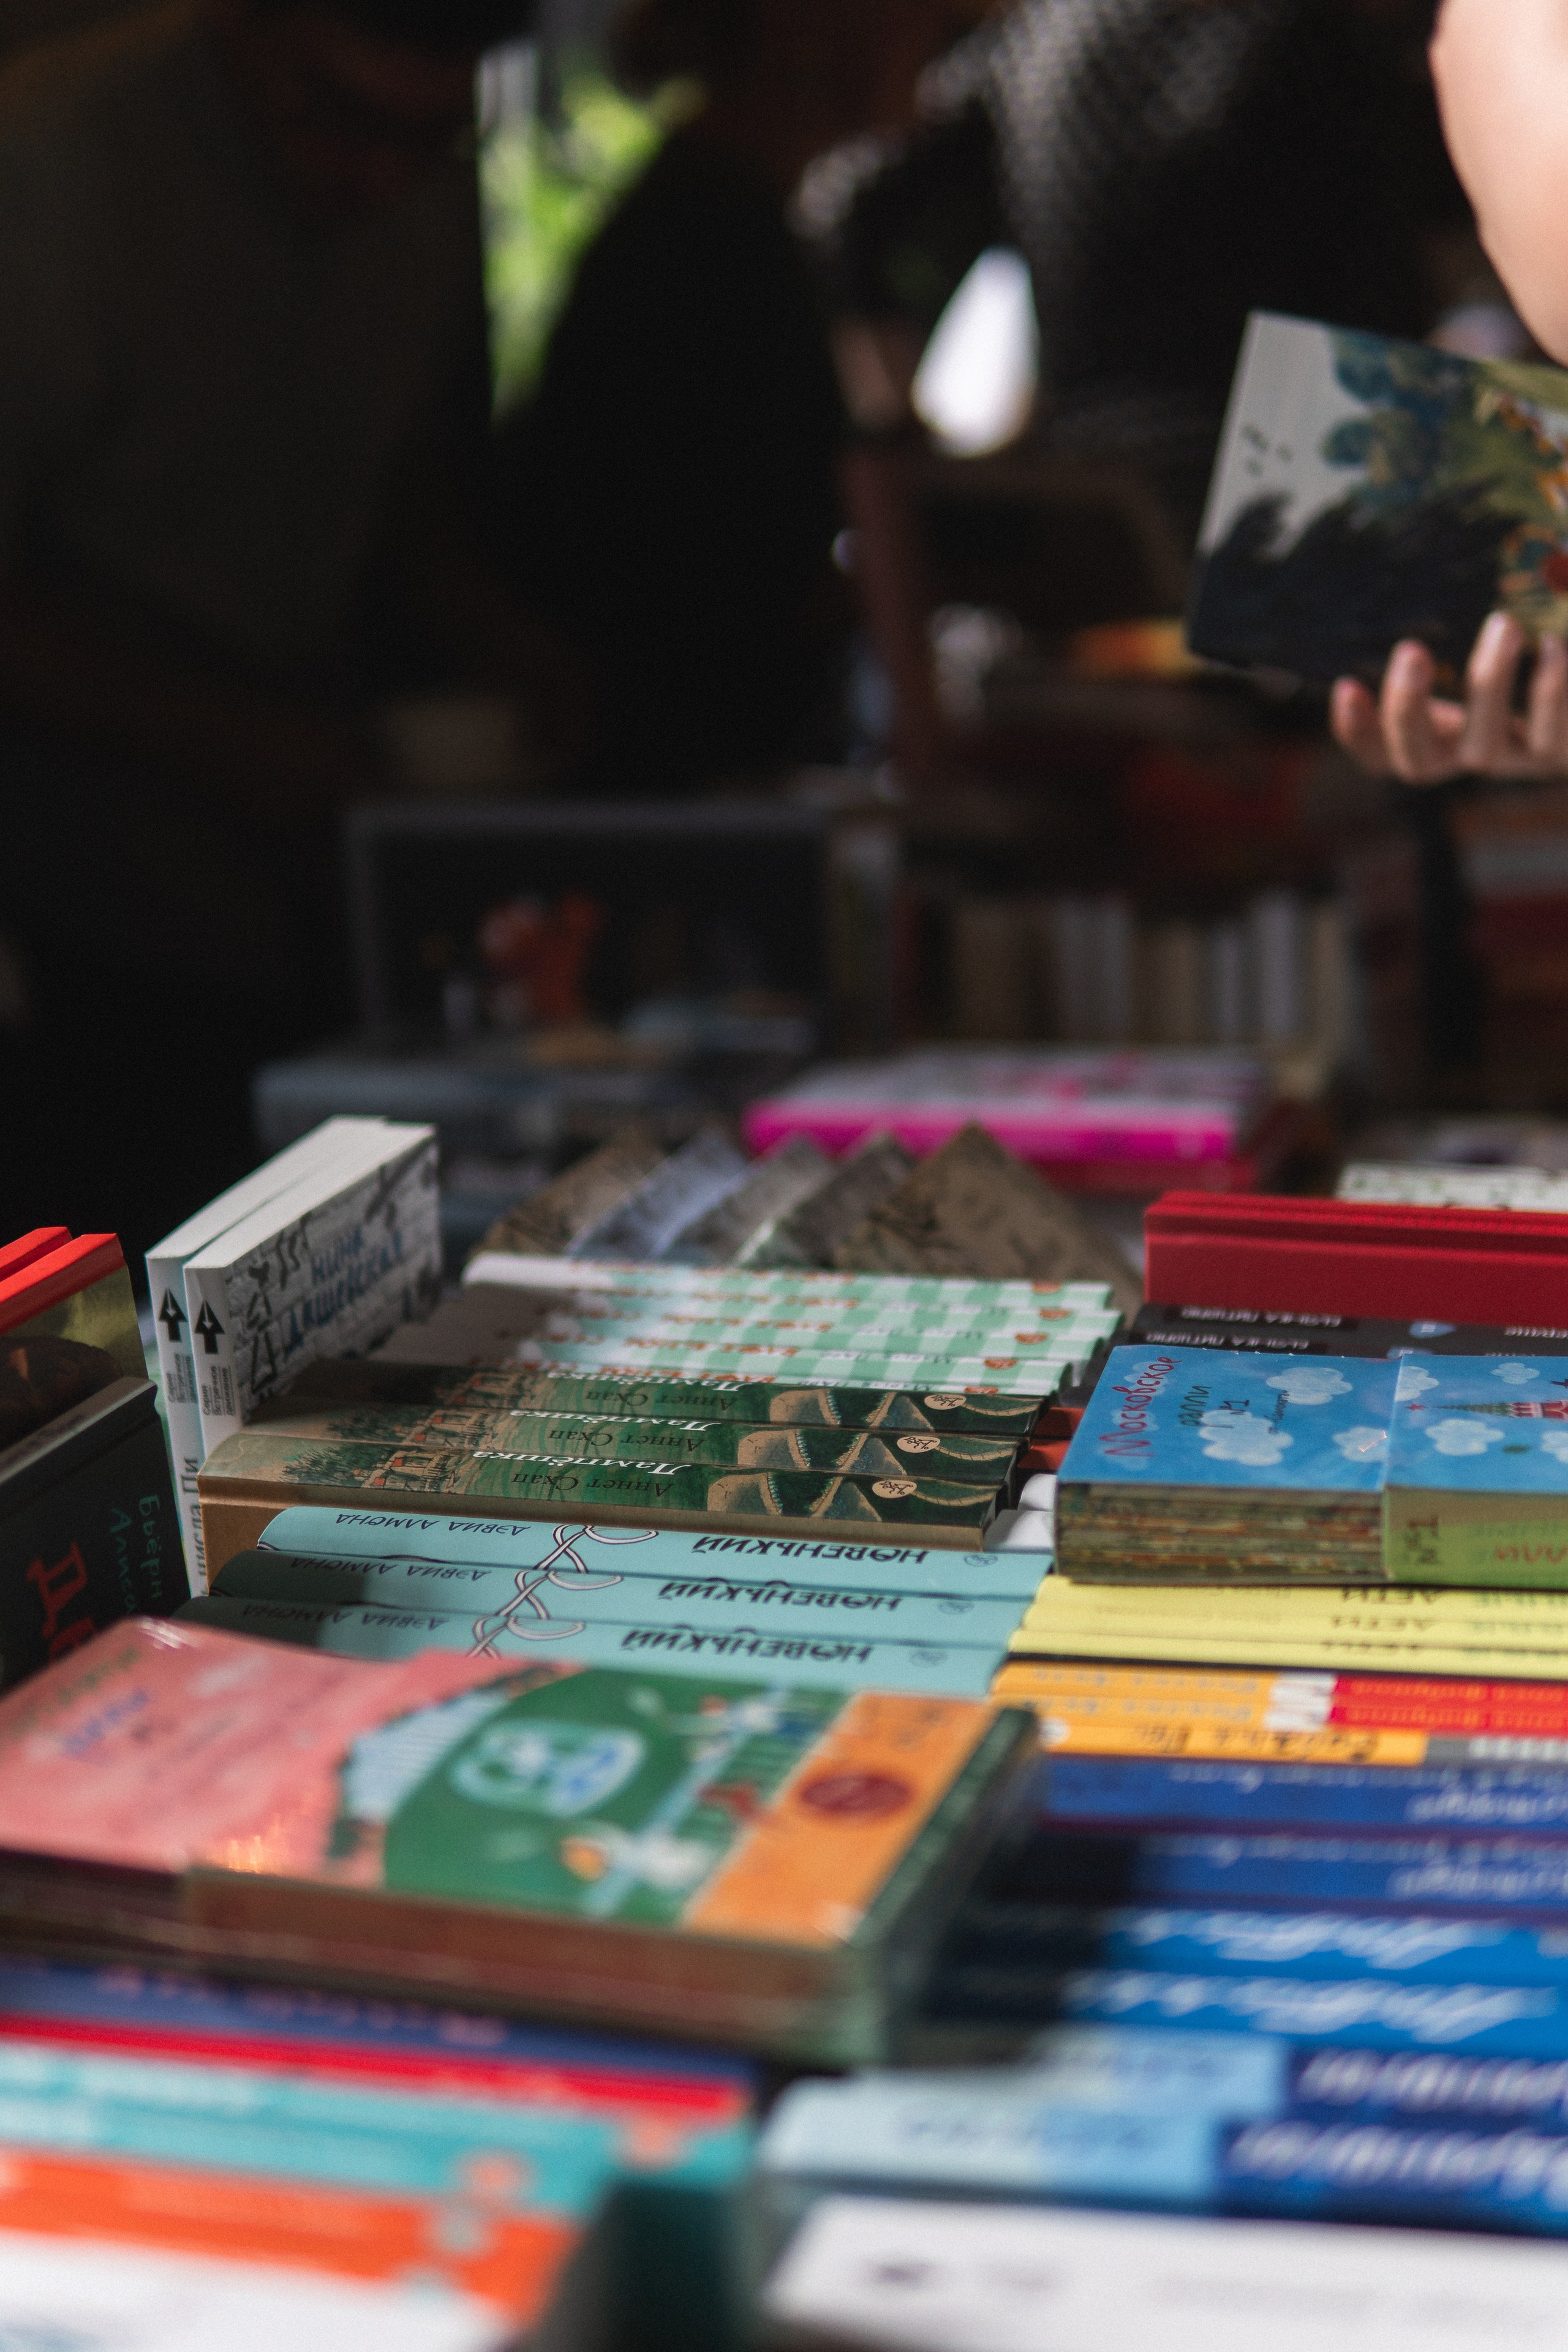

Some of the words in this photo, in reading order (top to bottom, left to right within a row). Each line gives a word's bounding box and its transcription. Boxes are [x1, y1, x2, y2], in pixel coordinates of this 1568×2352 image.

[584, 1389, 649, 1408] Схап
[655, 1395, 736, 1412] Аннет
[1099, 1356, 1182, 1457] Московское
[1177, 1385, 1234, 1429] ралли
[510, 1409, 722, 1433] Лампёшка
[545, 1428, 615, 1449] Схап
[620, 1433, 706, 1454] Аннет
[472, 1449, 692, 1476] Лампёшка
[181, 1457, 202, 1493] Пи
[510, 1470, 580, 1493] Схап
[584, 1476, 675, 1498] Аннет
[334, 1512, 440, 1532] АЛМОНД
[448, 1520, 531, 1538] ДЭВИД
[139, 1494, 162, 1599] Бьёрн
[692, 1536, 929, 1564] НОВЕНЬКИЙ
[290, 1556, 399, 1577] АЛМОНД
[405, 1564, 491, 1583] ДЭВИД
[658, 1580, 902, 1612] НОВЕНЬКИЙ
[360, 1611, 451, 1632] ДЭВИД
[621, 1628, 874, 1664] НОВЕНЬКИЙ
